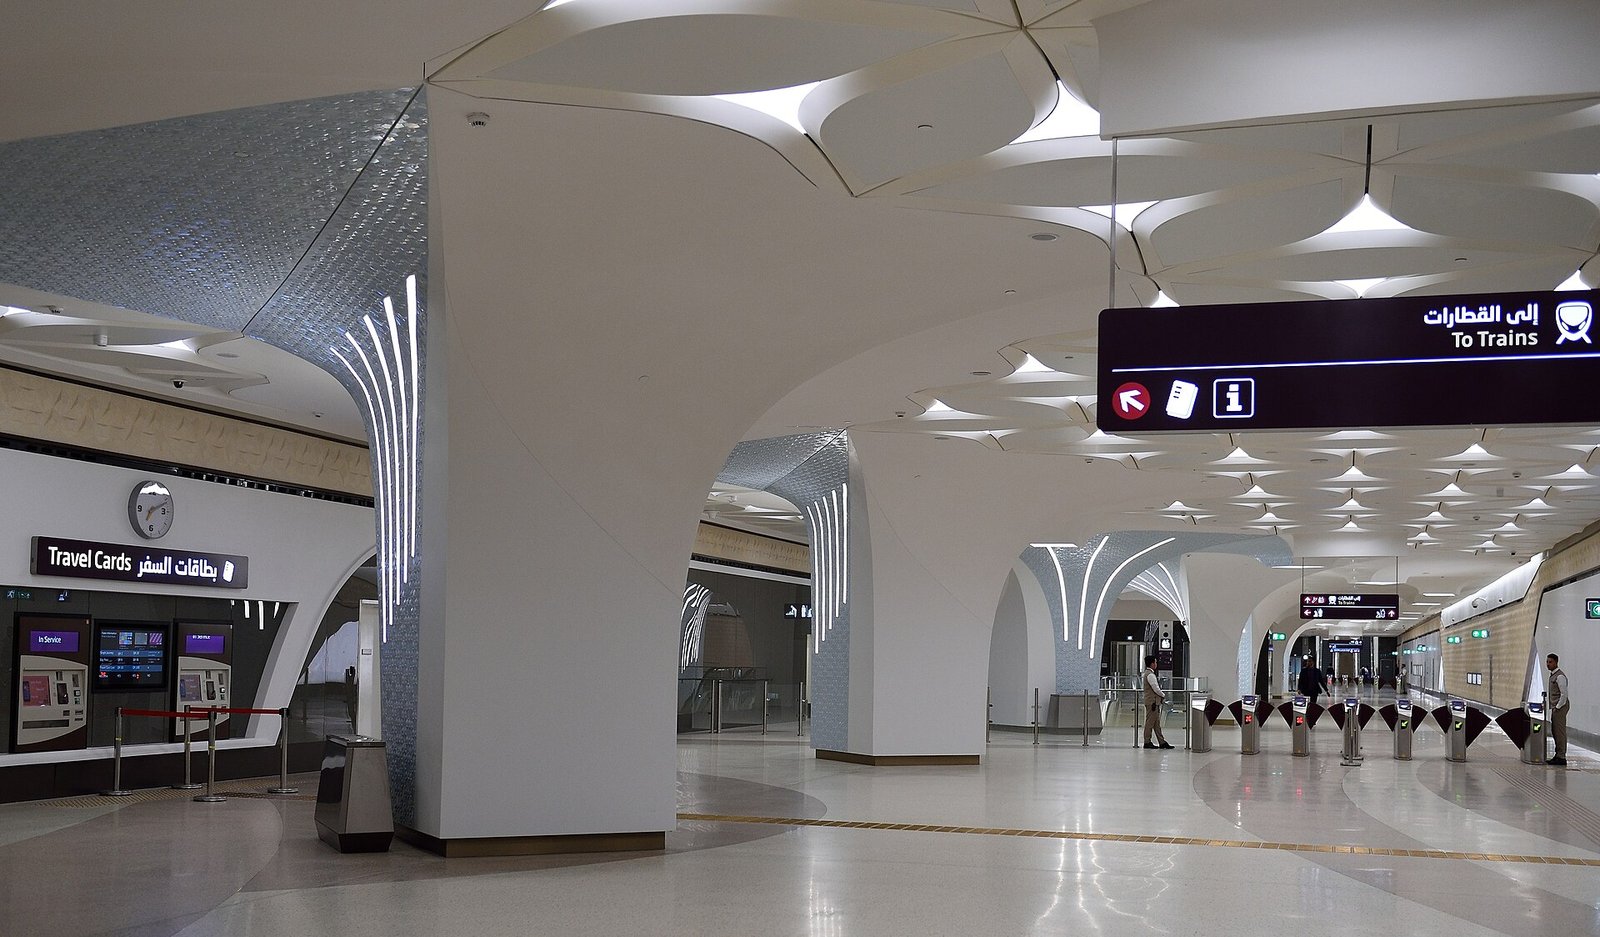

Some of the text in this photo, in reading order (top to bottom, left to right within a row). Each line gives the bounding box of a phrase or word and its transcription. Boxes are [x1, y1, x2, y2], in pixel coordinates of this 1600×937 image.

[1423, 302, 1539, 329] إلى القطارات
[1451, 329, 1539, 348] To Trains
[137, 504, 143, 513] 9
[161, 507, 166, 516] 3
[148, 524, 154, 532] 6
[48, 545, 132, 572] Travel Cards
[136, 555, 218, 583] بطاقات السفر
[38, 635, 62, 644] In Service
